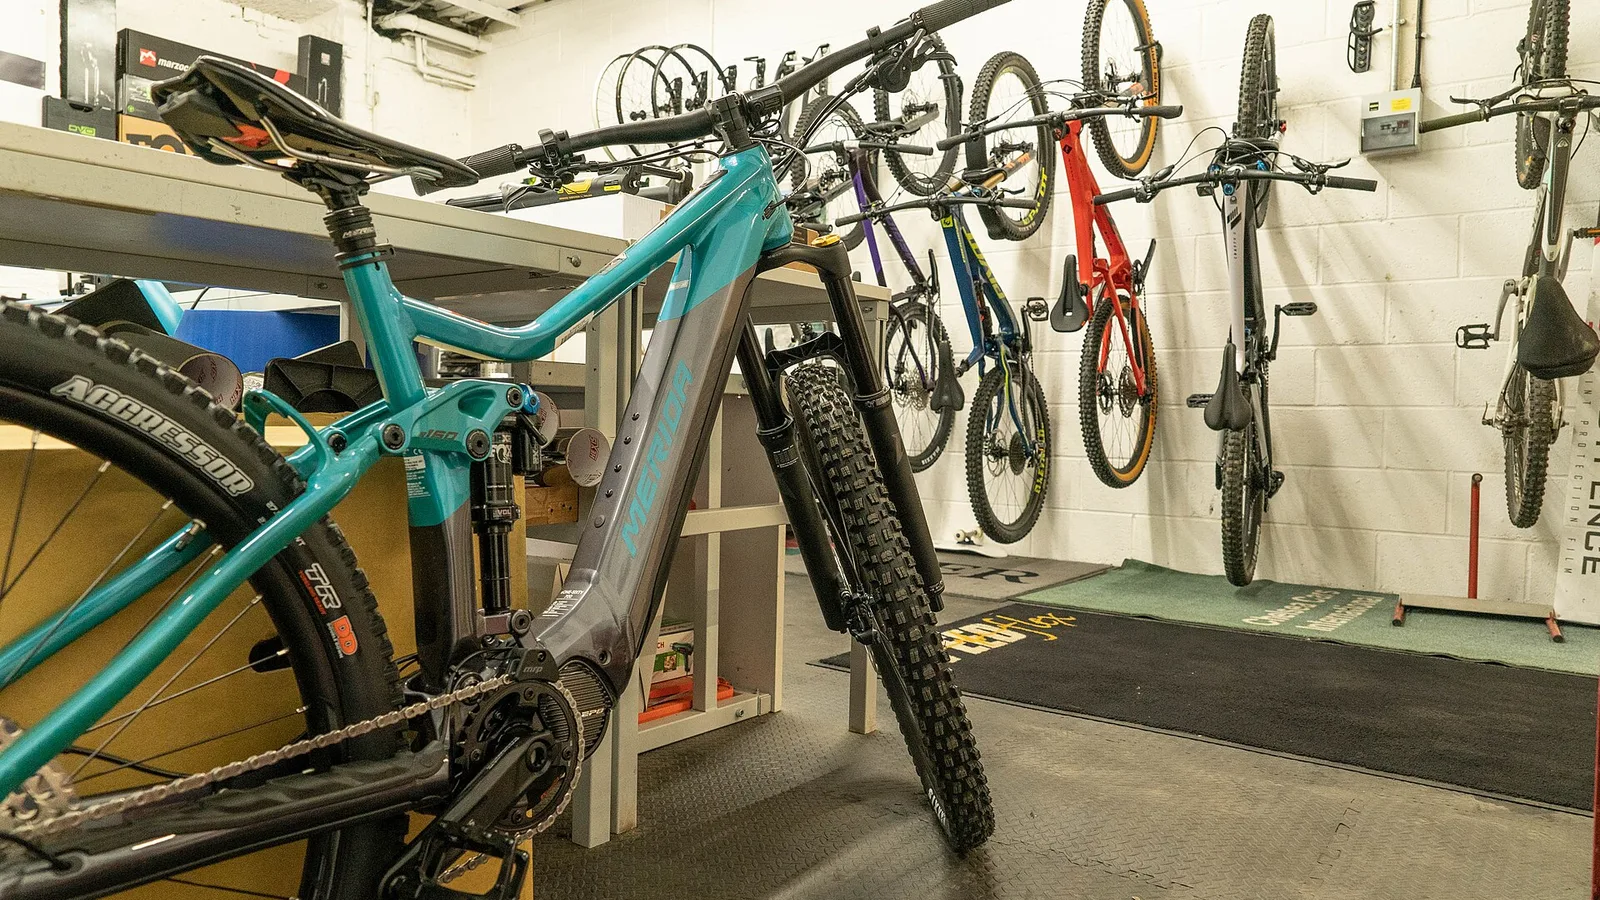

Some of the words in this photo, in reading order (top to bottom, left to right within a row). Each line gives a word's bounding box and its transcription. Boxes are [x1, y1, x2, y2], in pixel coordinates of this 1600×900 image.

[158, 57, 193, 73] marzoc
[621, 359, 694, 559] MERIDA
[1569, 420, 1590, 523] PROTECTION
[1563, 537, 1577, 574] FILM
[304, 562, 342, 609] TR
[331, 614, 358, 656] DD
[523, 666, 543, 674] mrp
